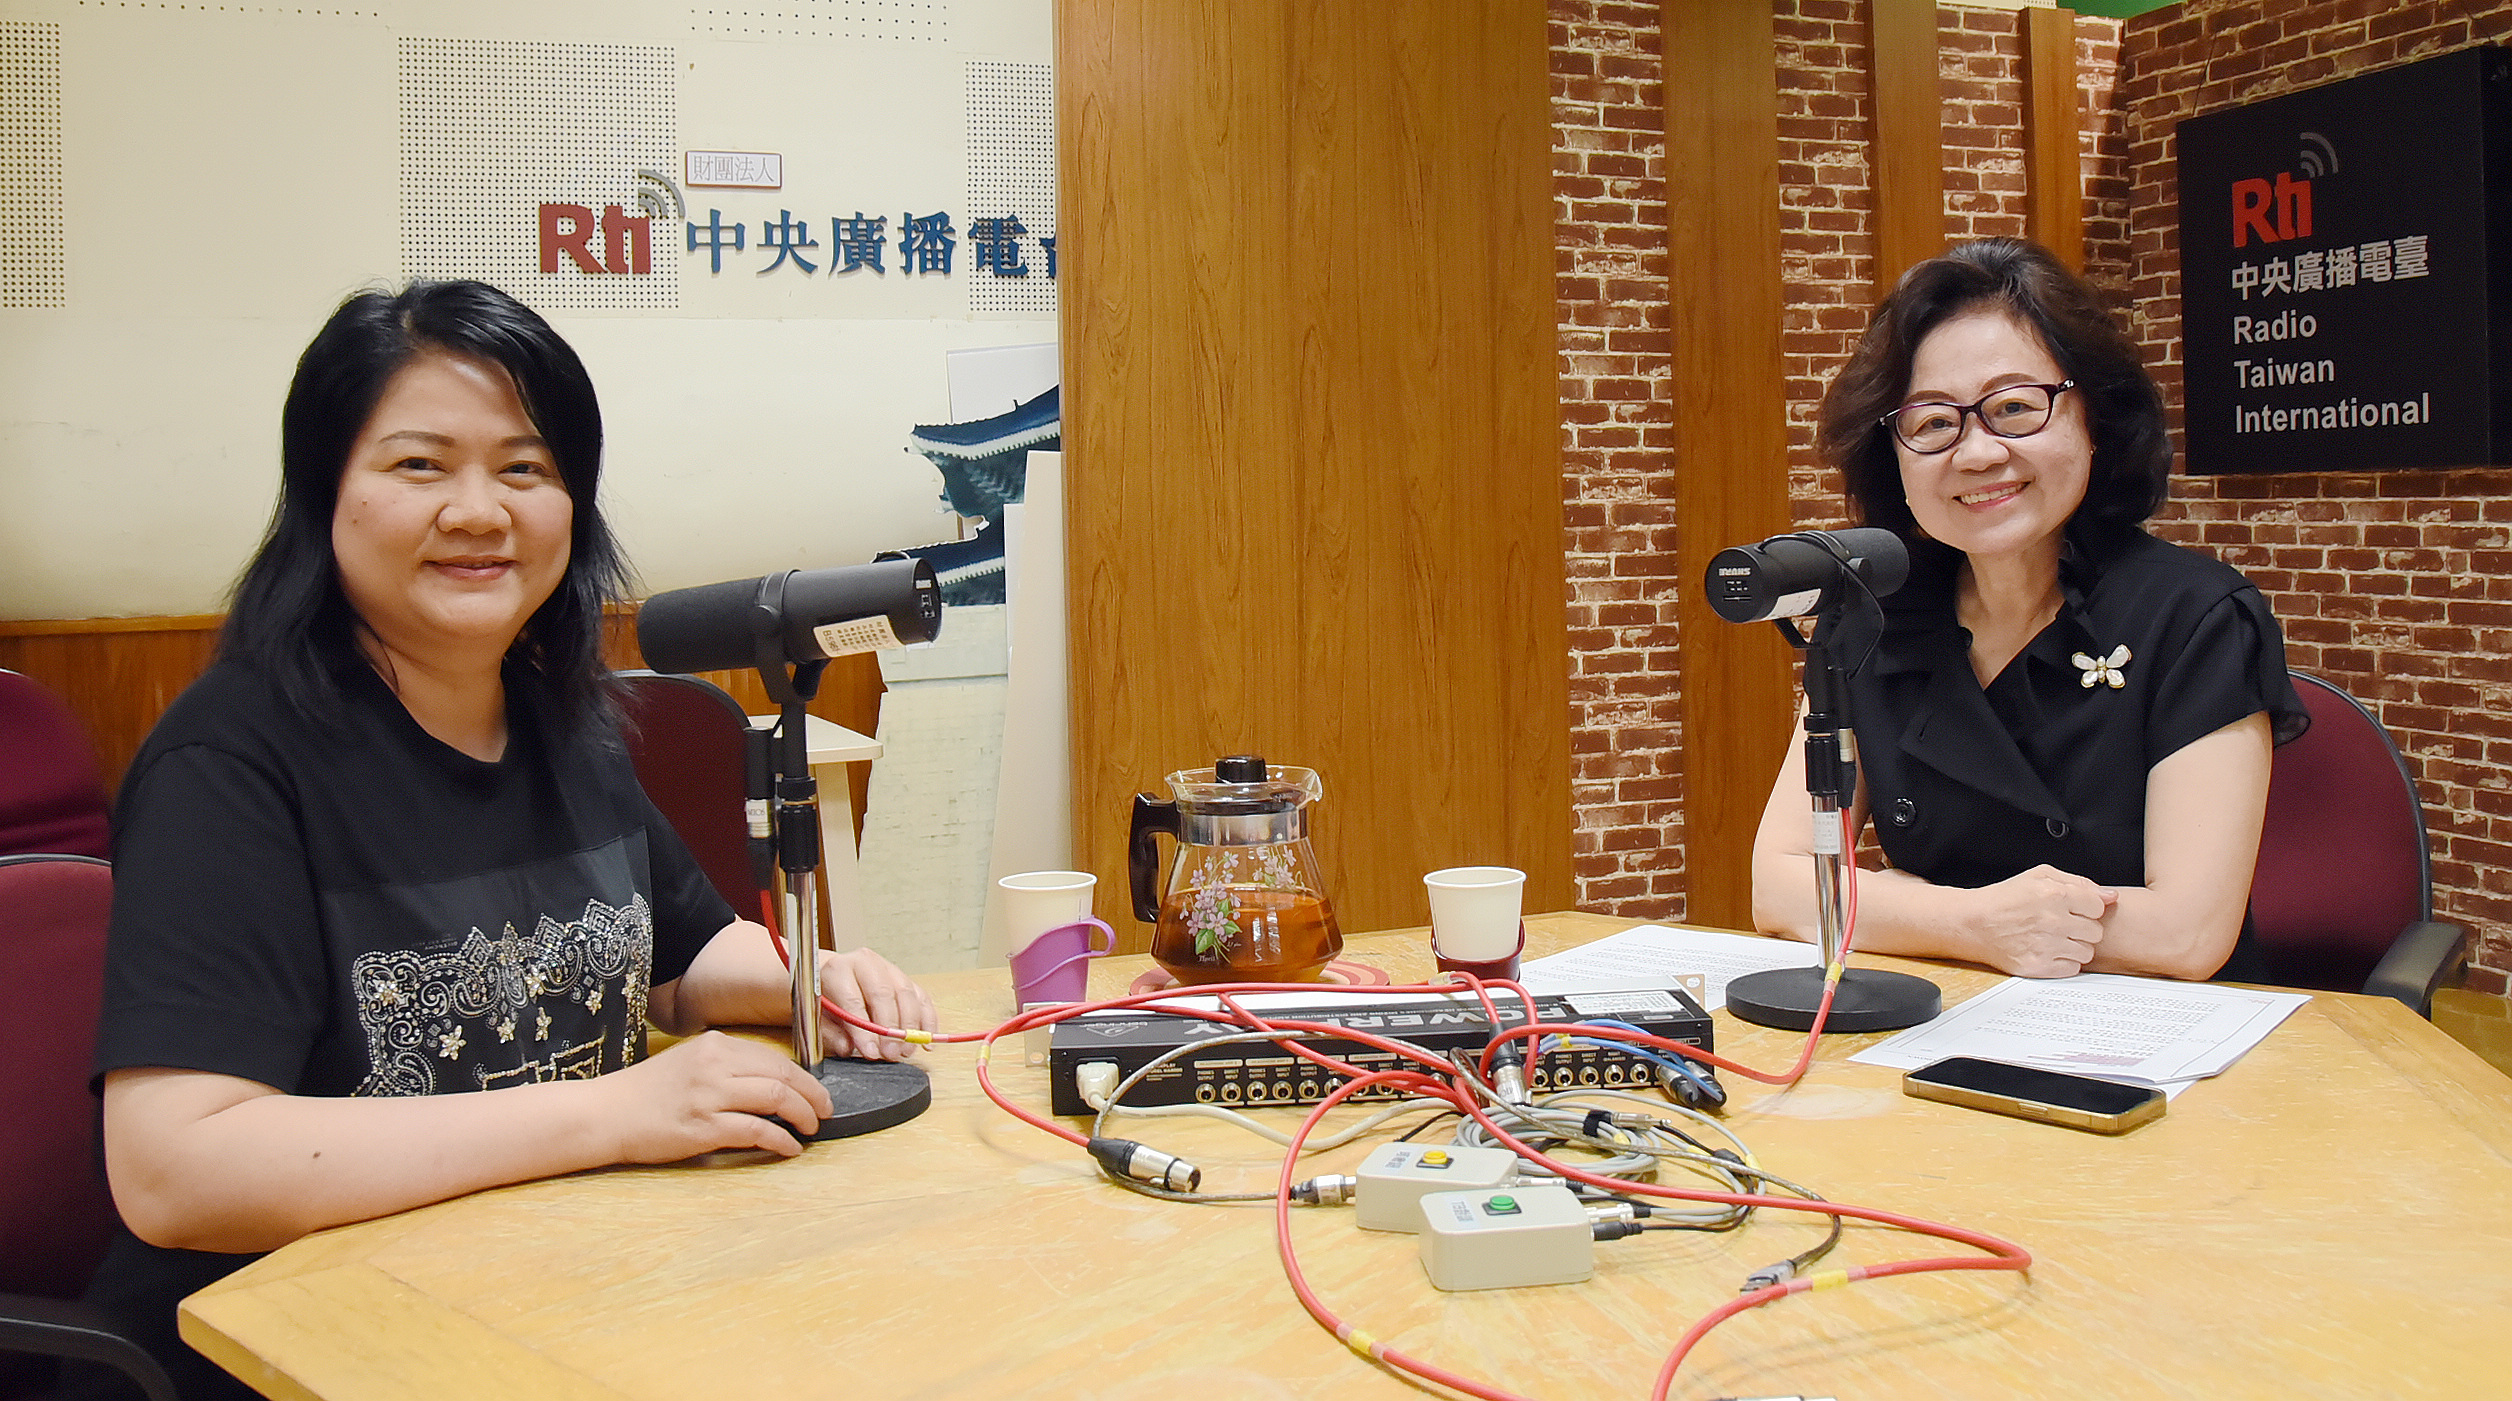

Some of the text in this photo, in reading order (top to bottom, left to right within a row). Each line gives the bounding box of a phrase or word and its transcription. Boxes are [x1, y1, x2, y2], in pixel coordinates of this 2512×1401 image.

[693, 155, 776, 184] 財團法人
[2231, 234, 2430, 300] 中央廣播電臺
[2233, 309, 2317, 345] Radio
[2233, 358, 2335, 389] Taiwan
[2235, 392, 2430, 433] International
